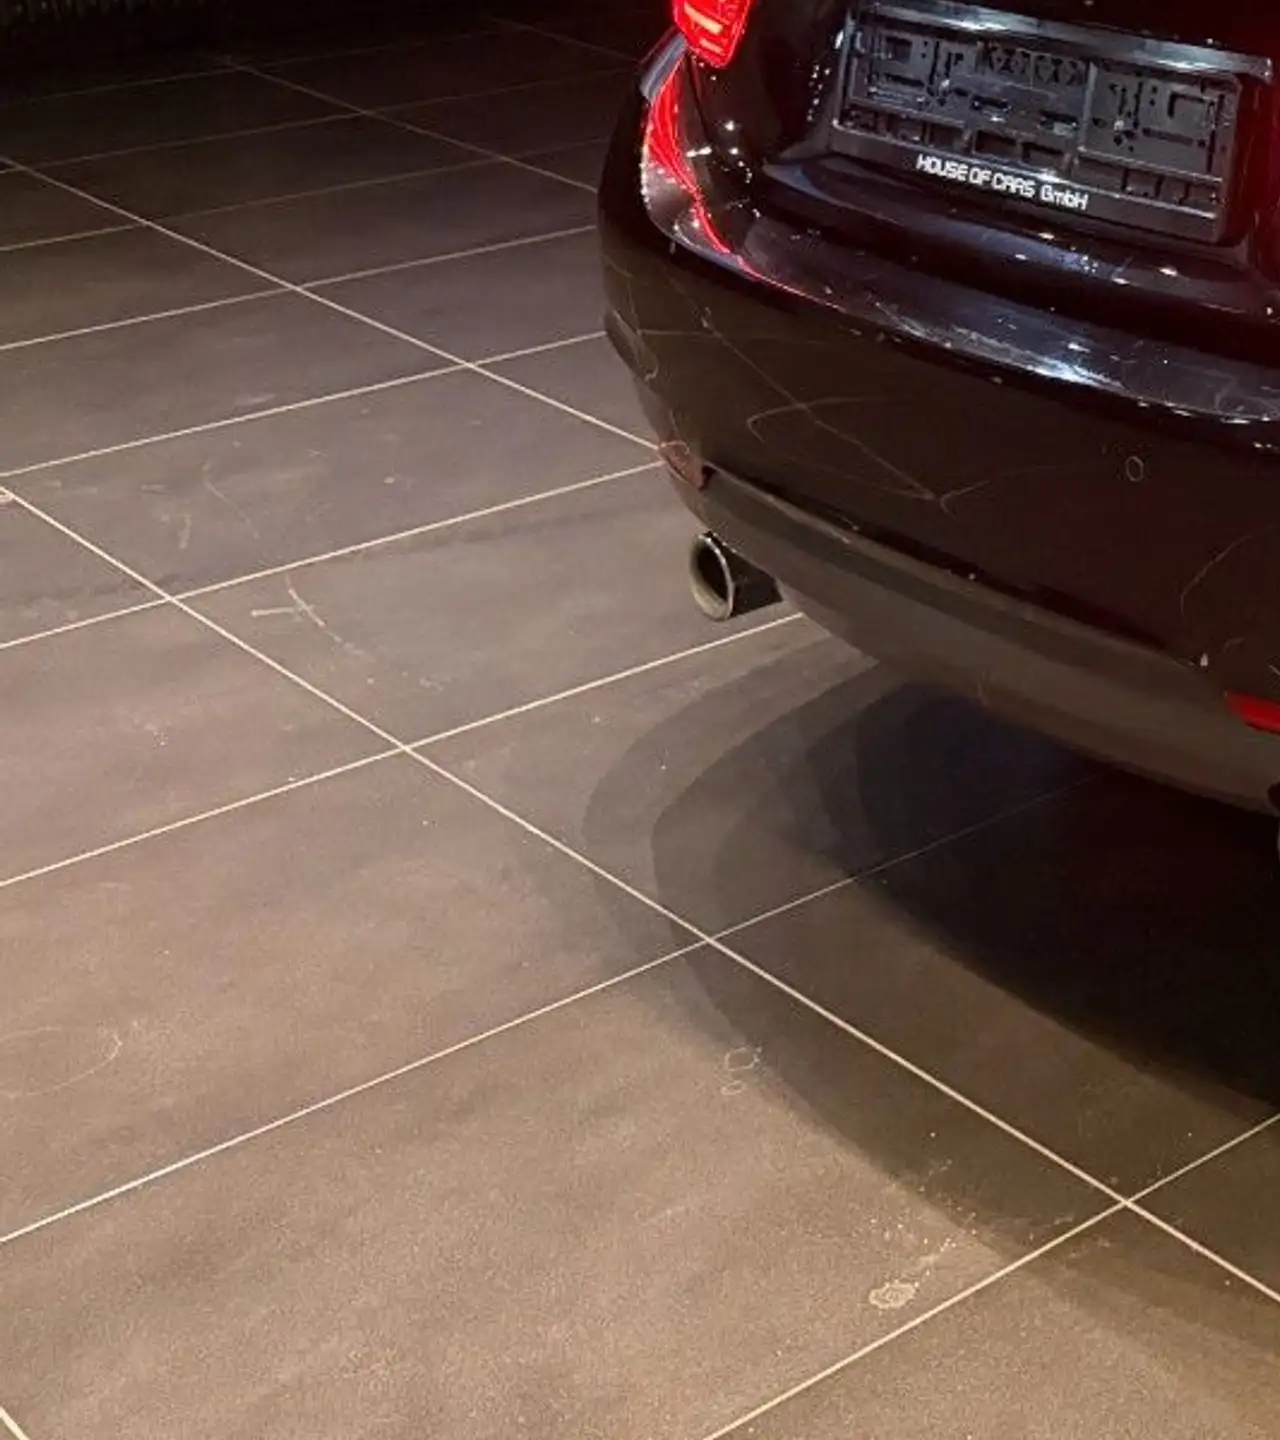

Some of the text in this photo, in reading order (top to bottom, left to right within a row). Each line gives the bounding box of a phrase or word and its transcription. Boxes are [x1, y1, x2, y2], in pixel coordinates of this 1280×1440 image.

[917, 154, 1090, 211] HOUSE OF CARS GmbH
